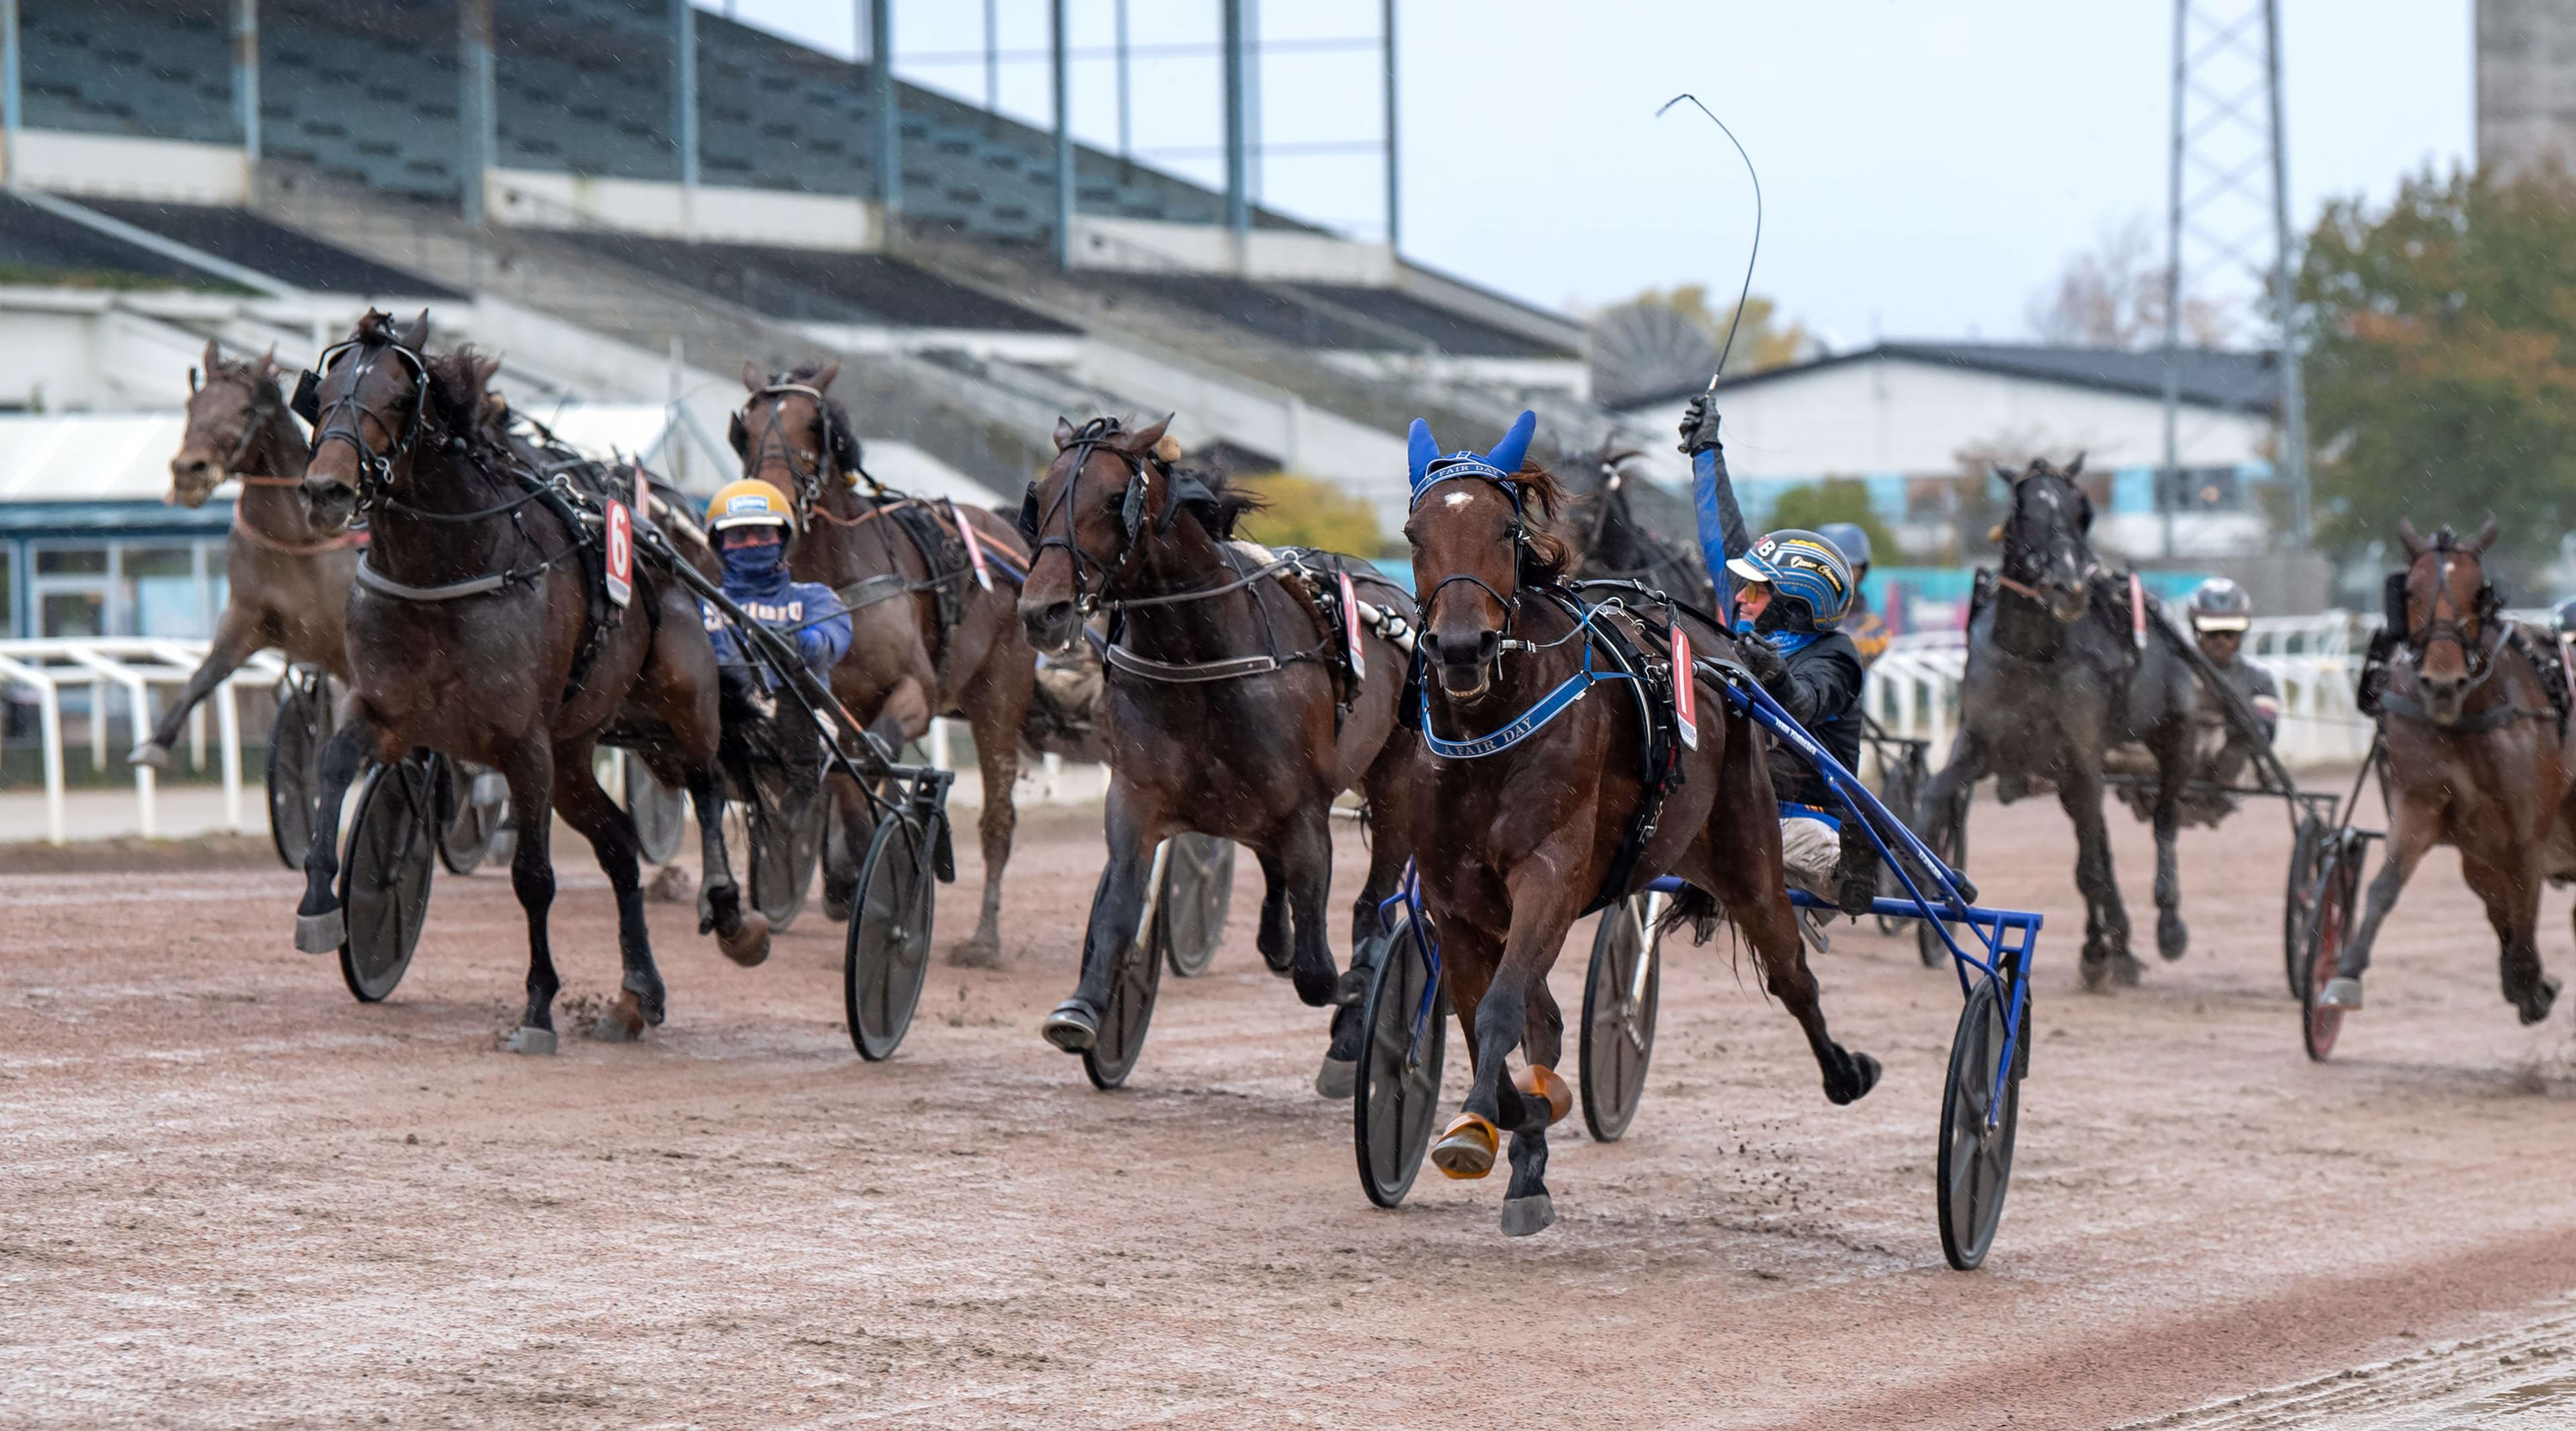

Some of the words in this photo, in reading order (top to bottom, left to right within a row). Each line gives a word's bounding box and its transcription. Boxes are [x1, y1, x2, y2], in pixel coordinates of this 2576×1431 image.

[1426, 476, 1434, 485] A
[1439, 466, 1469, 477] FAIR
[1475, 465, 1499, 476] DAY
[611, 504, 628, 578] 6
[1344, 578, 1362, 653] 2
[1676, 633, 1688, 714] 1
[1444, 745, 1454, 755] A
[1456, 740, 1497, 755] FAIR
[1503, 717, 1533, 743] DAY
